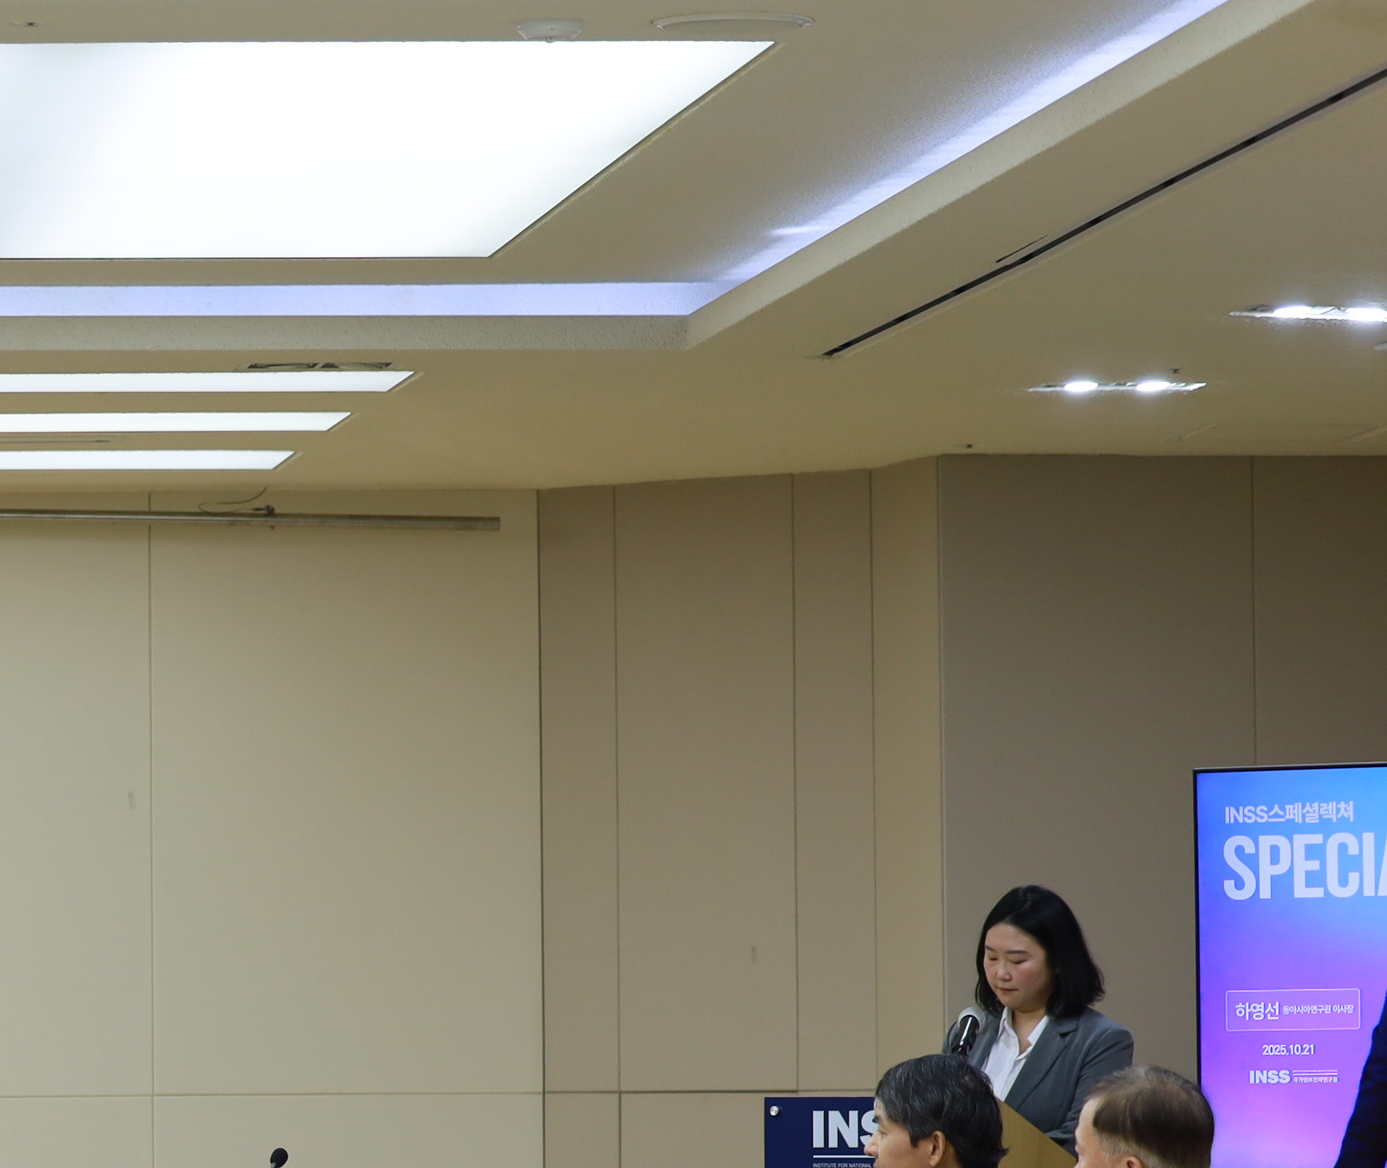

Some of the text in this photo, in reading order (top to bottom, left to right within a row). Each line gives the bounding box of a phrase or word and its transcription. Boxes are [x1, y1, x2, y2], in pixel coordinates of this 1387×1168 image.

[1225, 801, 1354, 824] INSS스페셜렉쳐
[1223, 832, 1387, 900] SPECI
[1235, 1001, 1280, 1021] 하영선
[1262, 1044, 1315, 1056] 2025.10.21
[1249, 1069, 1291, 1084] INSS
[813, 1109, 879, 1148] IN
